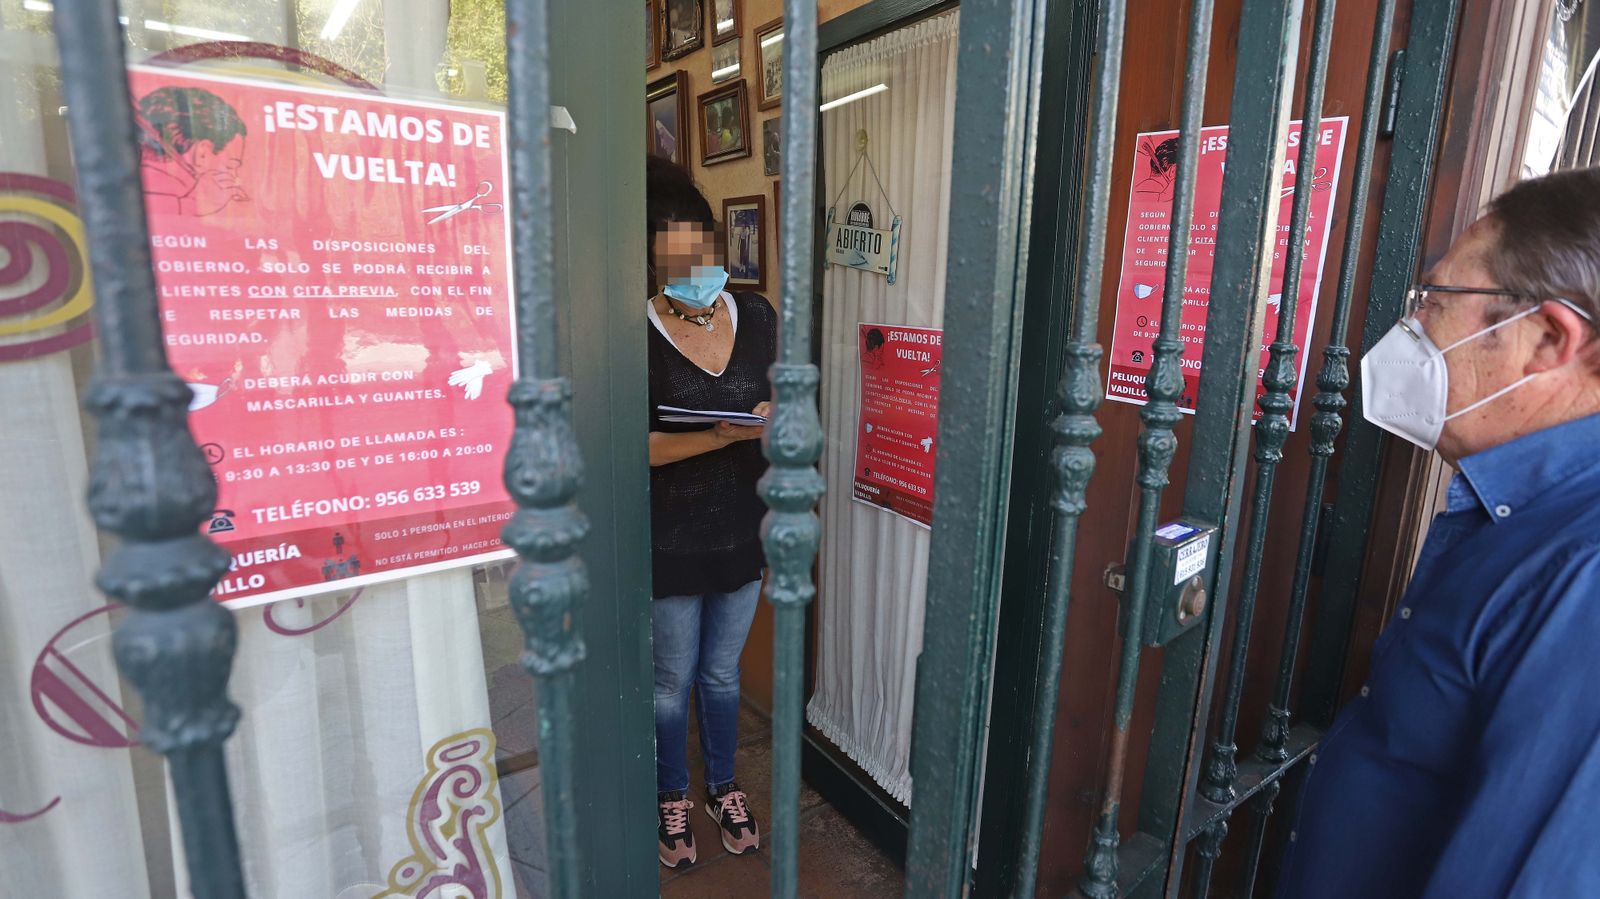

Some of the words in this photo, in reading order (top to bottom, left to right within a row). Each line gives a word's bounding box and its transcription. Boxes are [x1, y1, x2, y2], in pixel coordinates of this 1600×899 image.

[263, 101, 444, 144] ¡ESTAMOS
[452, 122, 490, 148] DE
[313, 152, 456, 188] VUELTA!
[152, 234, 206, 248] EGÚN
[244, 238, 278, 250] LAS
[312, 240, 436, 254] DISPOSICIONES
[463, 244, 490, 255] DEL
[836, 227, 882, 254] ABIERTO
[156, 260, 250, 274] OBIERNO,
[262, 262, 310, 274] SOLO
[322, 263, 342, 274] SE
[416, 264, 472, 275] RECIBIR
[482, 266, 490, 275] A
[161, 286, 242, 297] LIENTES
[248, 286, 288, 298] CON
[293, 286, 332, 298] CITA
[410, 286, 442, 296] CON
[448, 286, 464, 296] EL
[470, 286, 492, 296] FIN
[210, 308, 301, 320] RESPETAR
[329, 307, 360, 318] LAS
[386, 306, 452, 317] MEDIDAS
[476, 306, 493, 316] DE
[166, 332, 268, 346] EGURIDAD.
[888, 330, 928, 344] ¡ESTAMOS
[930, 334, 942, 346] DE
[896, 348, 930, 362] VUELTA!
[317, 372, 376, 384] ACUDIR
[381, 370, 414, 382] CON
[246, 394, 354, 412] MASCARILLA
[359, 394, 368, 404] Y
[372, 388, 446, 403] GUANTES.
[233, 448, 254, 458] EL
[260, 440, 336, 456] HORARIO
[340, 436, 360, 448] DE
[365, 430, 436, 446] LLAMADA
[440, 428, 456, 438] ES
[225, 468, 263, 482] 9:30
[269, 466, 280, 477] A
[286, 461, 330, 475] 13:30
[336, 458, 356, 470] DE
[360, 456, 370, 466] Y
[374, 454, 394, 465] DE
[400, 449, 438, 462] 16:00
[442, 448, 452, 457] A
[456, 443, 492, 456] 20:00
[917, 486, 926, 495] 539
[252, 496, 370, 524] TELÉFONO:
[375, 490, 410, 508] 956
[414, 484, 446, 502] 633
[450, 480, 480, 497] 539
[374, 529, 399, 541] SOLO
[402, 528, 408, 537] 1
[410, 522, 451, 535] PERSONA
[454, 520, 465, 528] EN
[466, 518, 476, 526] EL
[375, 557, 388, 566] NO
[414, 546, 458, 560] PERMITIDO
[462, 540, 488, 551] HACER
[216, 574, 265, 596] ILLO
